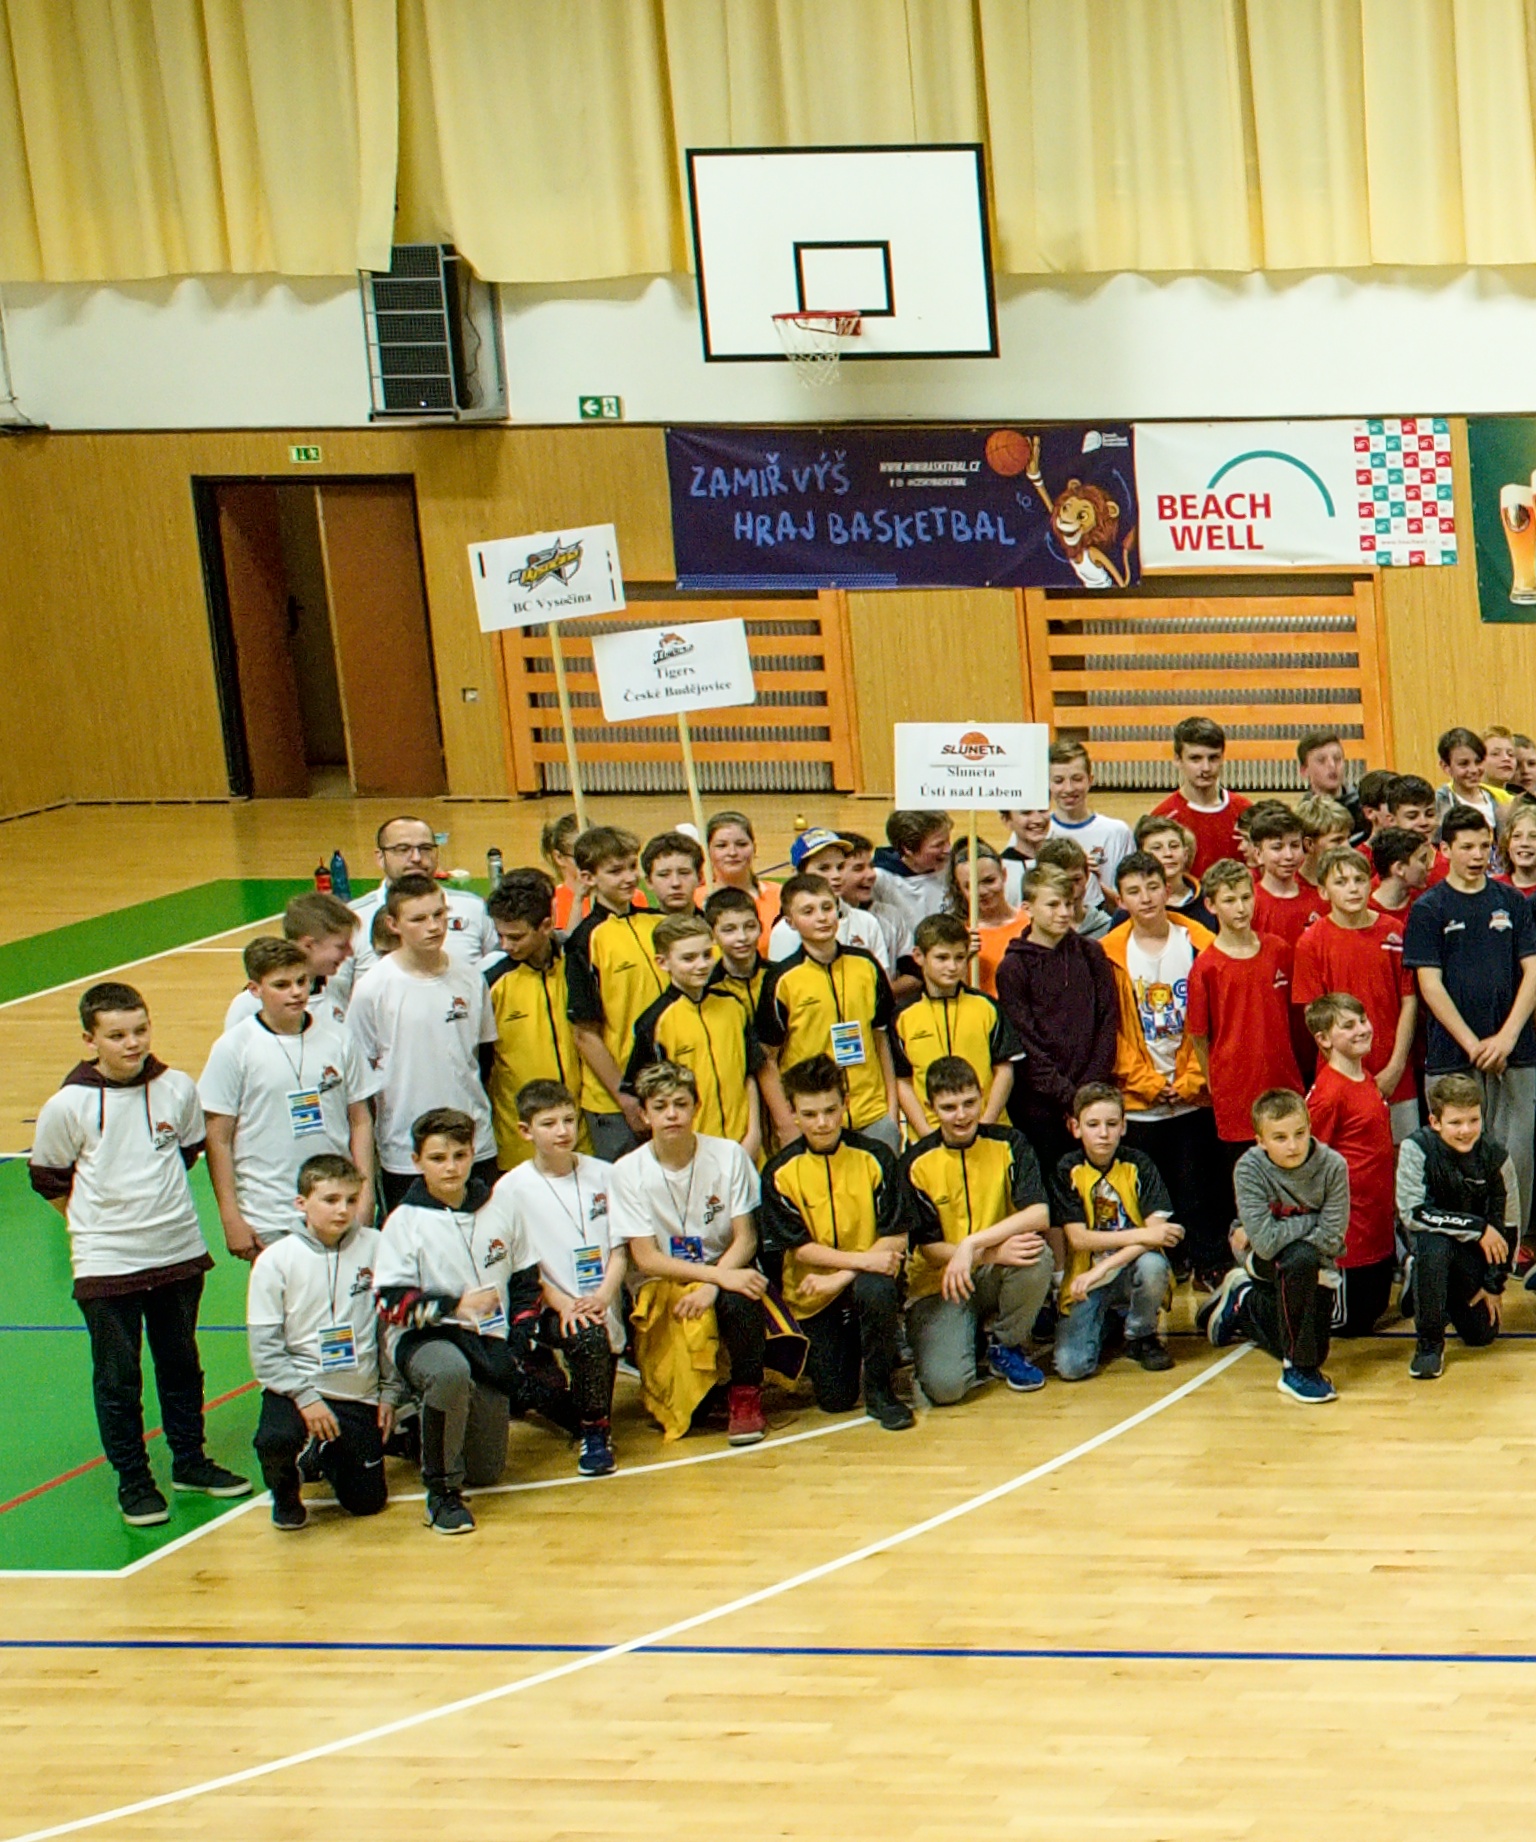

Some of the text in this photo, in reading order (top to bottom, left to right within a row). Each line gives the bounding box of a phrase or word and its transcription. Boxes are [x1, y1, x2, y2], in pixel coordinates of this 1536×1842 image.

[689, 450, 851, 498] ZAMIŘ VÝŠ
[1157, 493, 1271, 520] BEACH
[734, 507, 1016, 548] HRAJ BASKETBAL
[1170, 524, 1264, 551] WELL
[513, 592, 593, 614] BC Vysočina
[655, 667, 697, 680] Tigers
[623, 680, 732, 703] České Budějovice
[941, 744, 1007, 755] SLUNETA
[946, 766, 996, 778] Sluneta
[920, 784, 1022, 797] Ústí nad Labem
